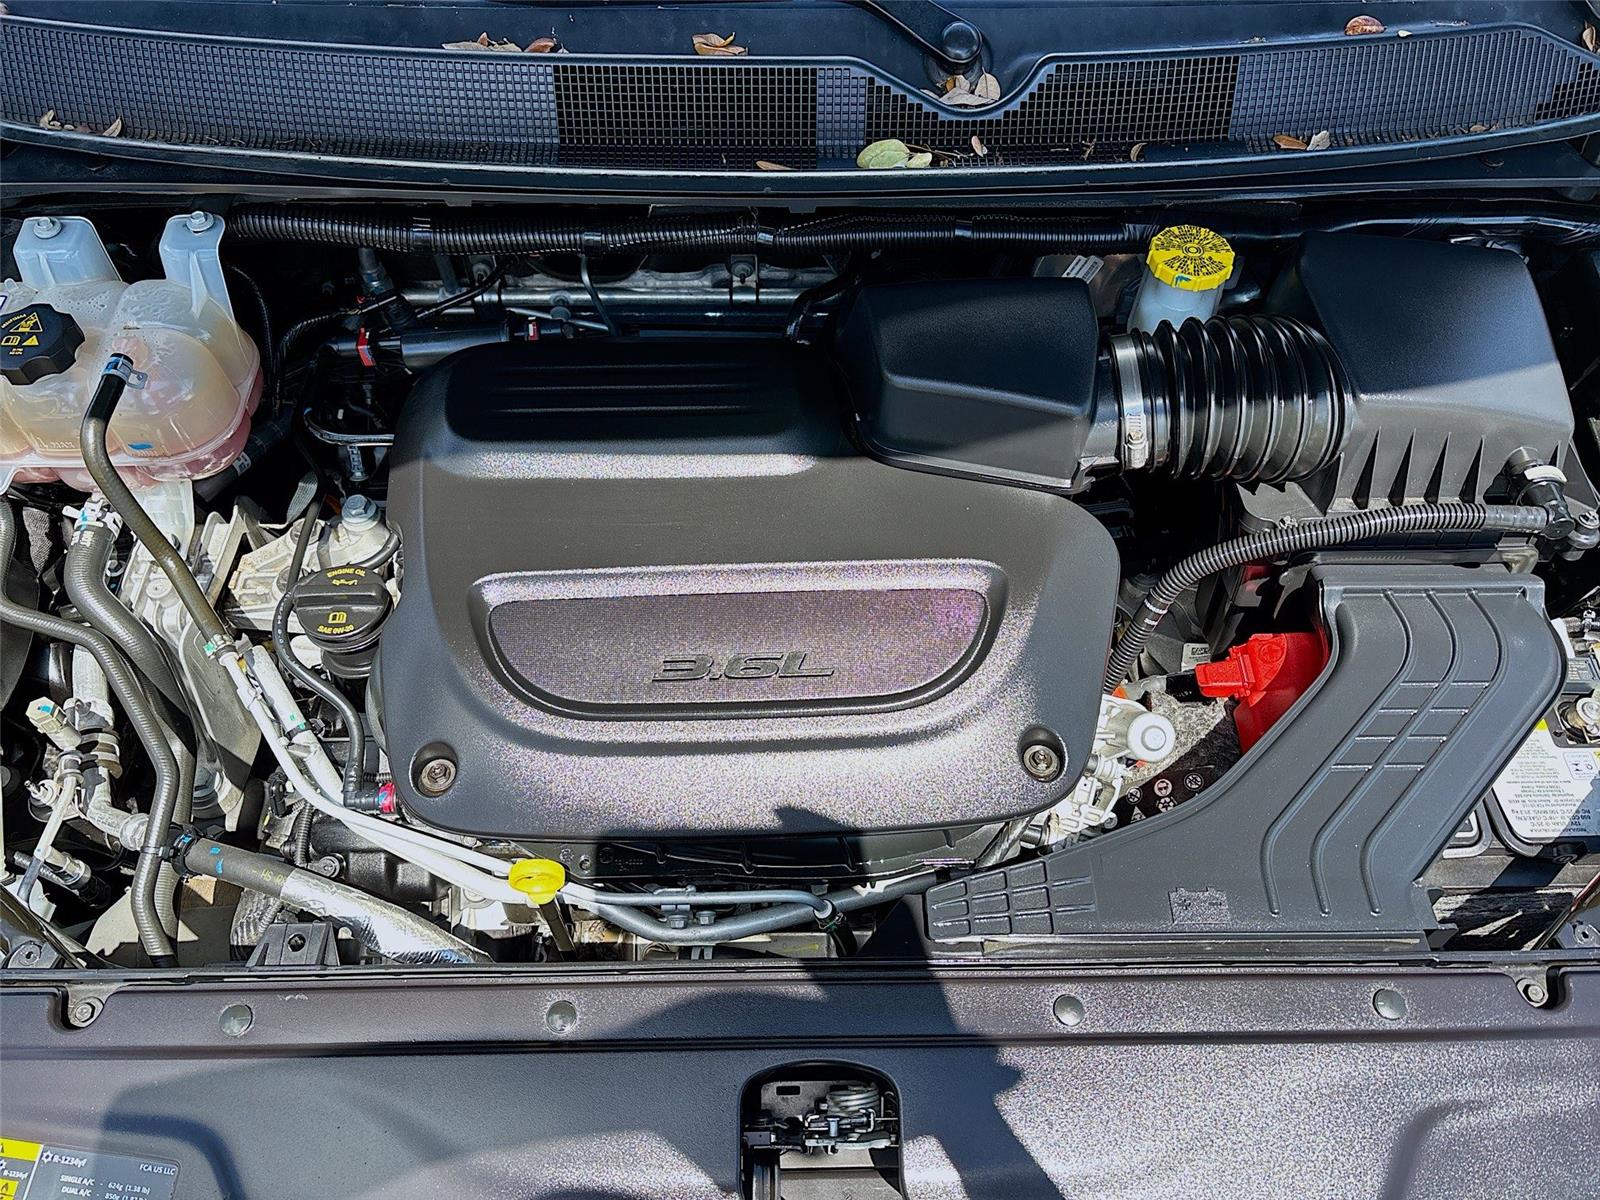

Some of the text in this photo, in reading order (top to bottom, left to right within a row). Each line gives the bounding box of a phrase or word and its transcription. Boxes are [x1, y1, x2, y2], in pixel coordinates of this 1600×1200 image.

[326, 568, 366, 578] ENGINE OIL
[317, 625, 332, 634] SAE
[651, 651, 835, 682] 3.6L
[53, 1154, 176, 1176] R-1234yf FCA US LLC
[60, 1174, 83, 1185] SINGLE
[82, 1178, 95, 1186] A/C
[108, 1182, 123, 1191] 624g
[61, 1186, 79, 1194] DUAL
[79, 1188, 92, 1197] A/C
